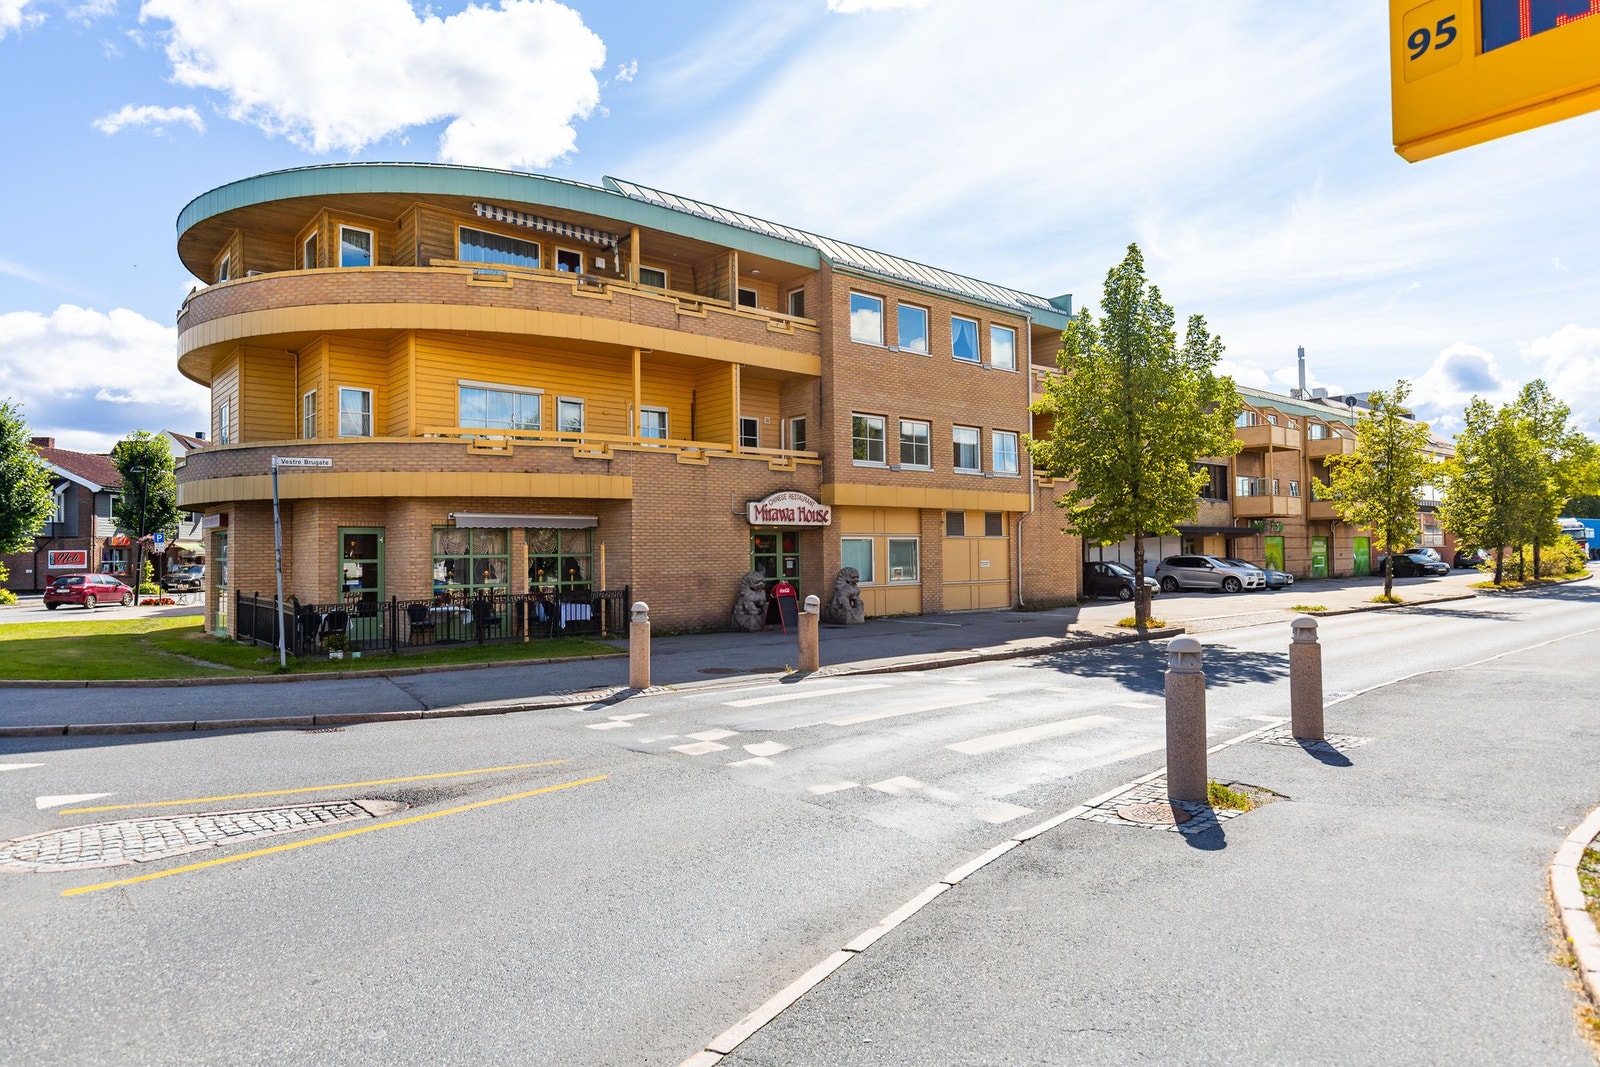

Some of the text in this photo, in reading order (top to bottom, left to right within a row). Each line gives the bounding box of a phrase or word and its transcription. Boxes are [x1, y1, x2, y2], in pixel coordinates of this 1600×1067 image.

[1407, 14, 1457, 61] 95
[768, 493, 816, 508] CHINESE RESTAURANT
[754, 503, 829, 523] Mirawa House
[156, 534, 163, 542] P
